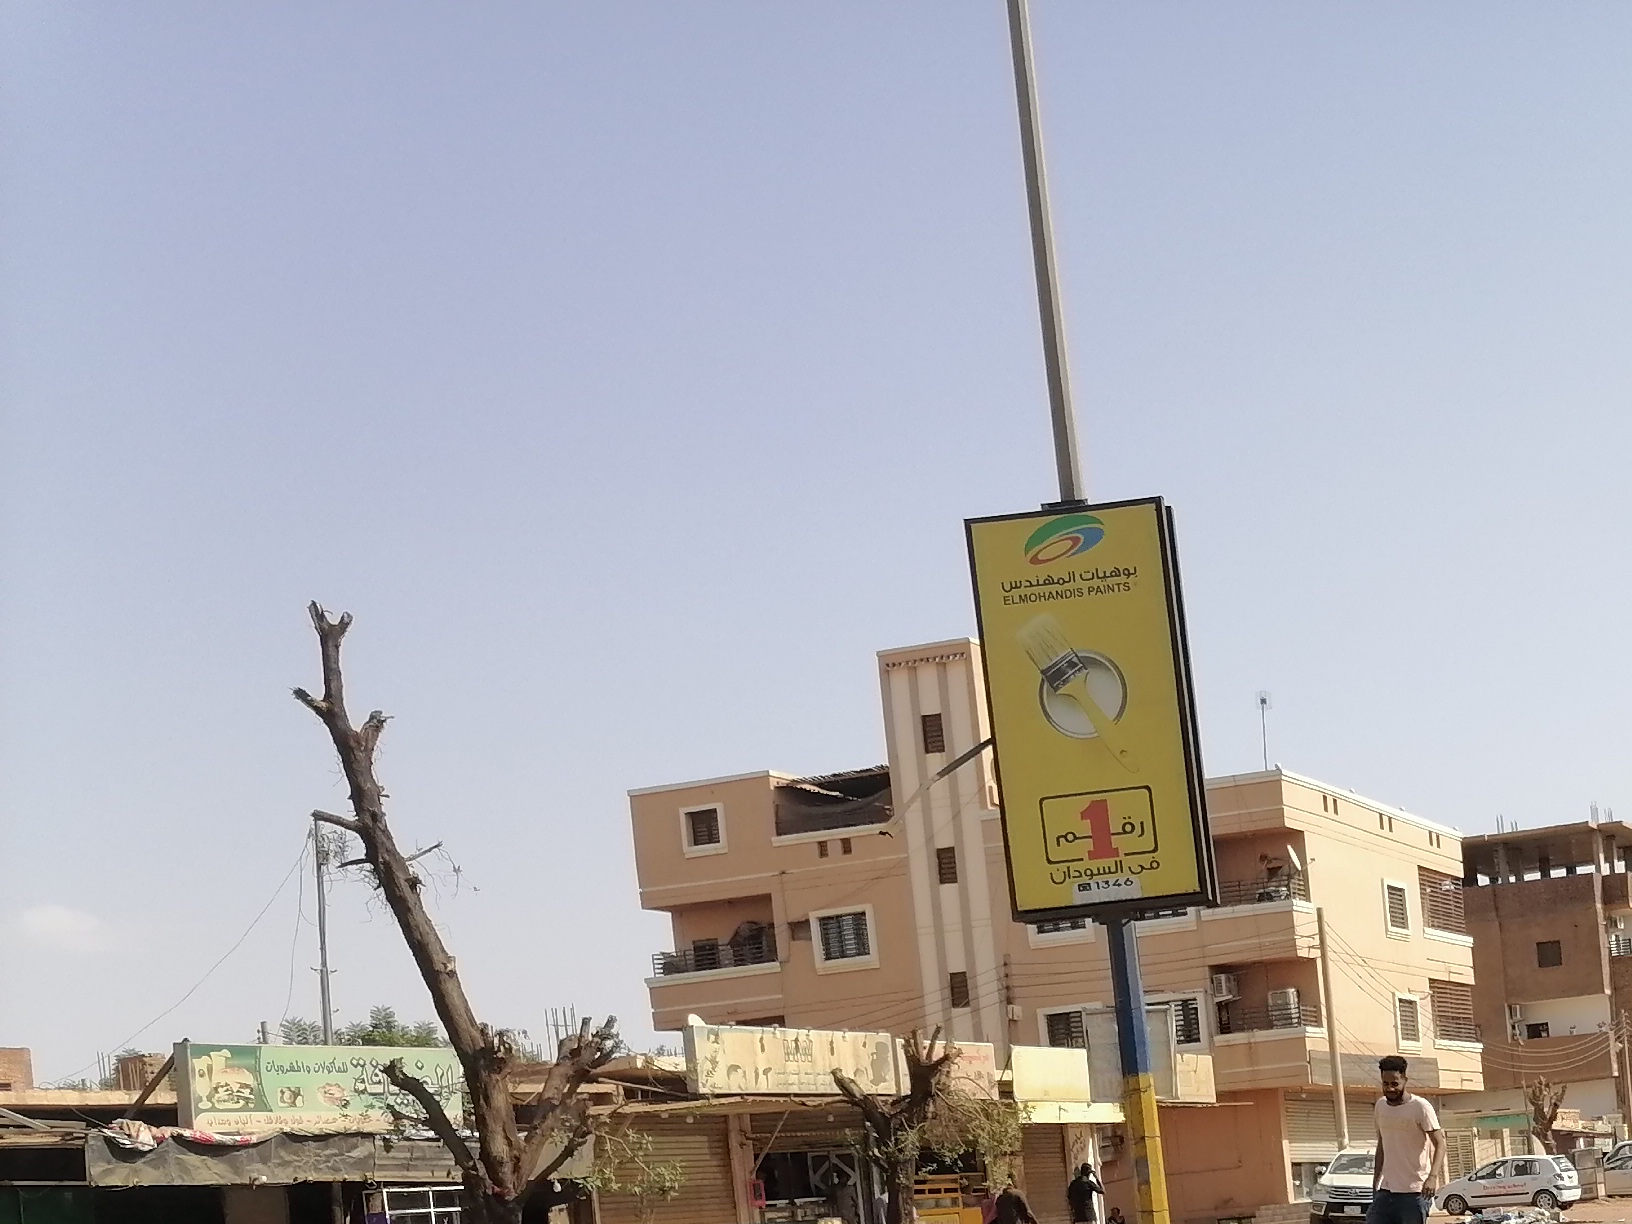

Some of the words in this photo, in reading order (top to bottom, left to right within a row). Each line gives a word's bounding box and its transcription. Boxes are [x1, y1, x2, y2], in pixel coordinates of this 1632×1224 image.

[1001, 571, 1076, 593] المهندس
[1079, 566, 1138, 582] بوهيات
[1003, 587, 1084, 606] ELMOHANDIS
[1087, 581, 1131, 596] PAINTS
[1080, 799, 1120, 861] 1
[1050, 859, 1124, 885] السودان
[1095, 878, 1134, 890] 1346
